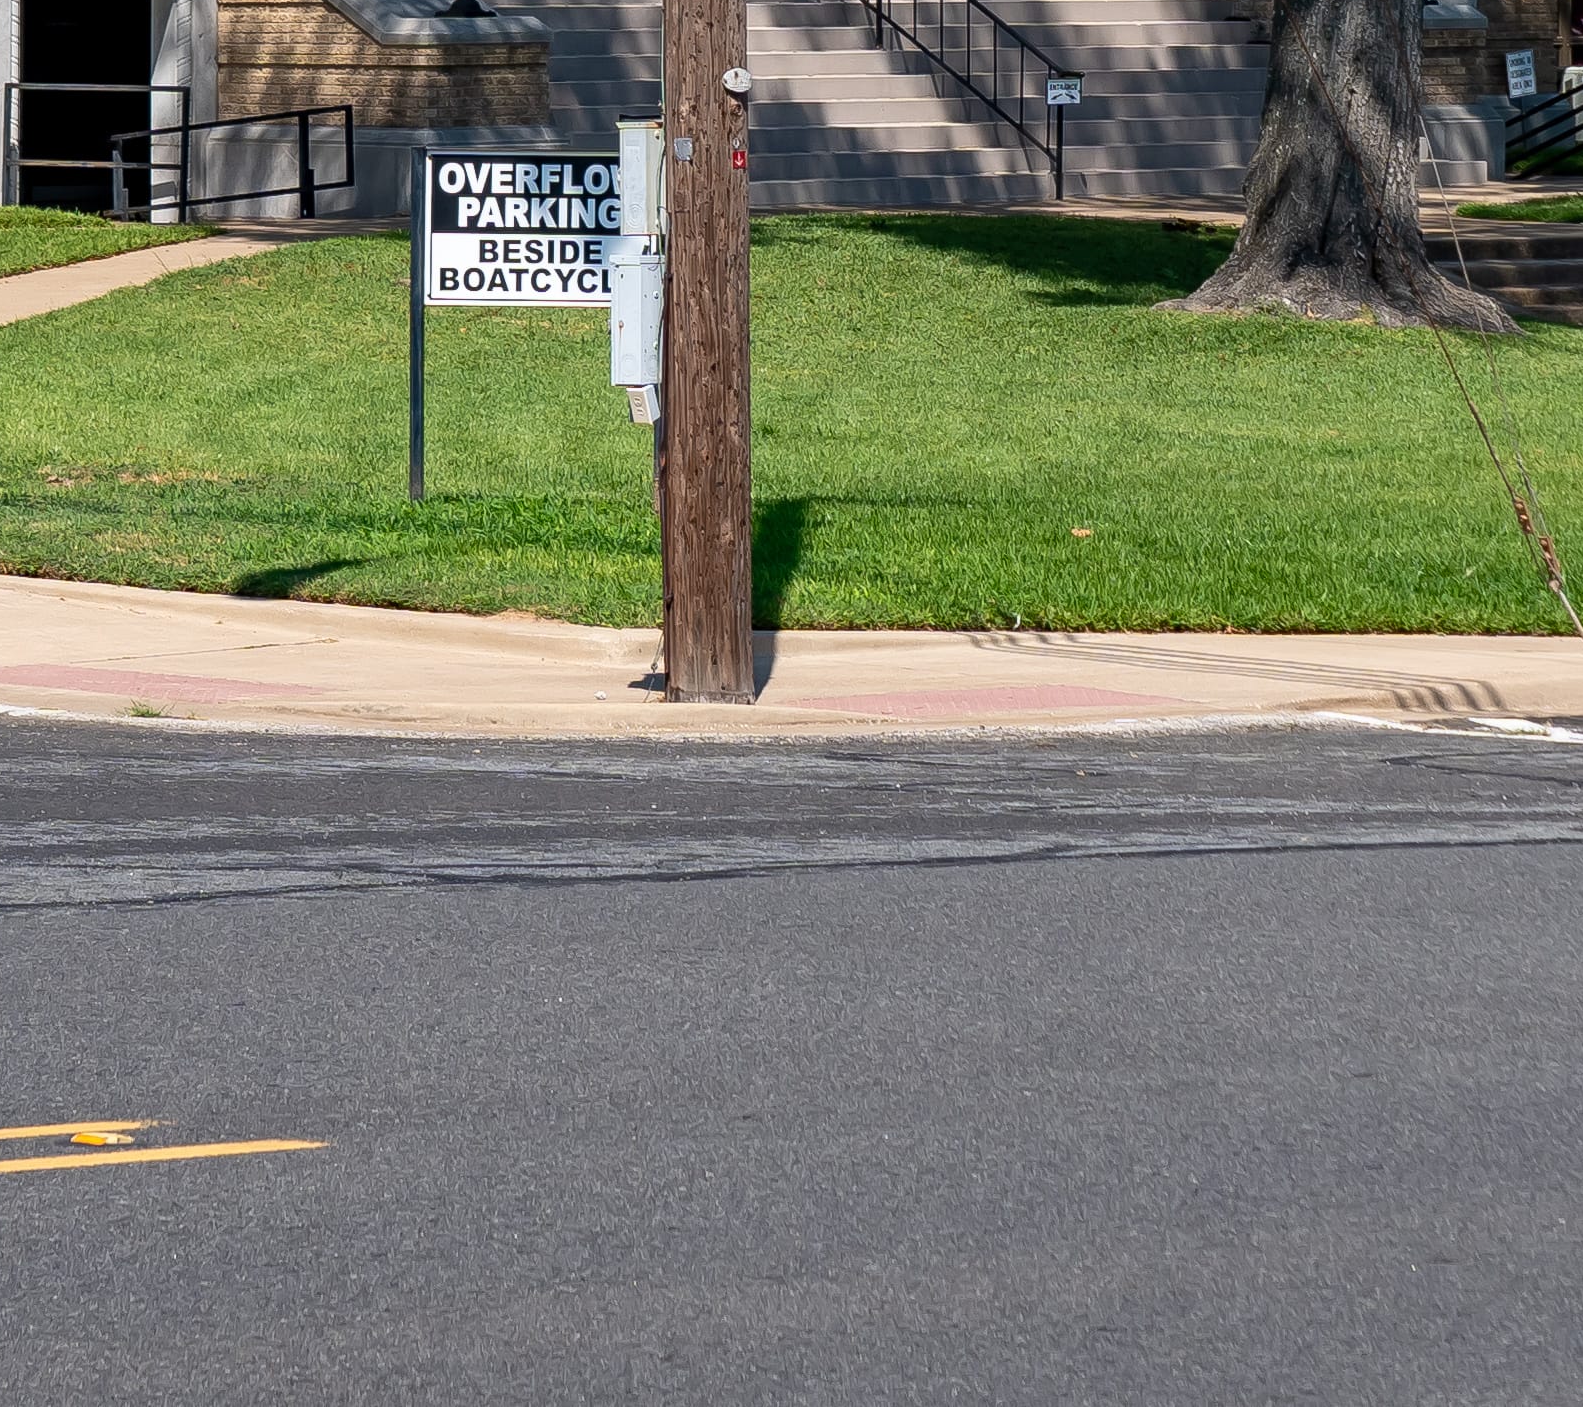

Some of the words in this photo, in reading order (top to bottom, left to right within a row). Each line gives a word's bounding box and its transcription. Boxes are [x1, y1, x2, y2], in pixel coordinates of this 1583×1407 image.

[1049, 82, 1079, 91] ENTRANCE
[457, 198, 621, 229] PARKING
[479, 240, 603, 265] BESIDE
[439, 268, 612, 293] BOATCYCL
